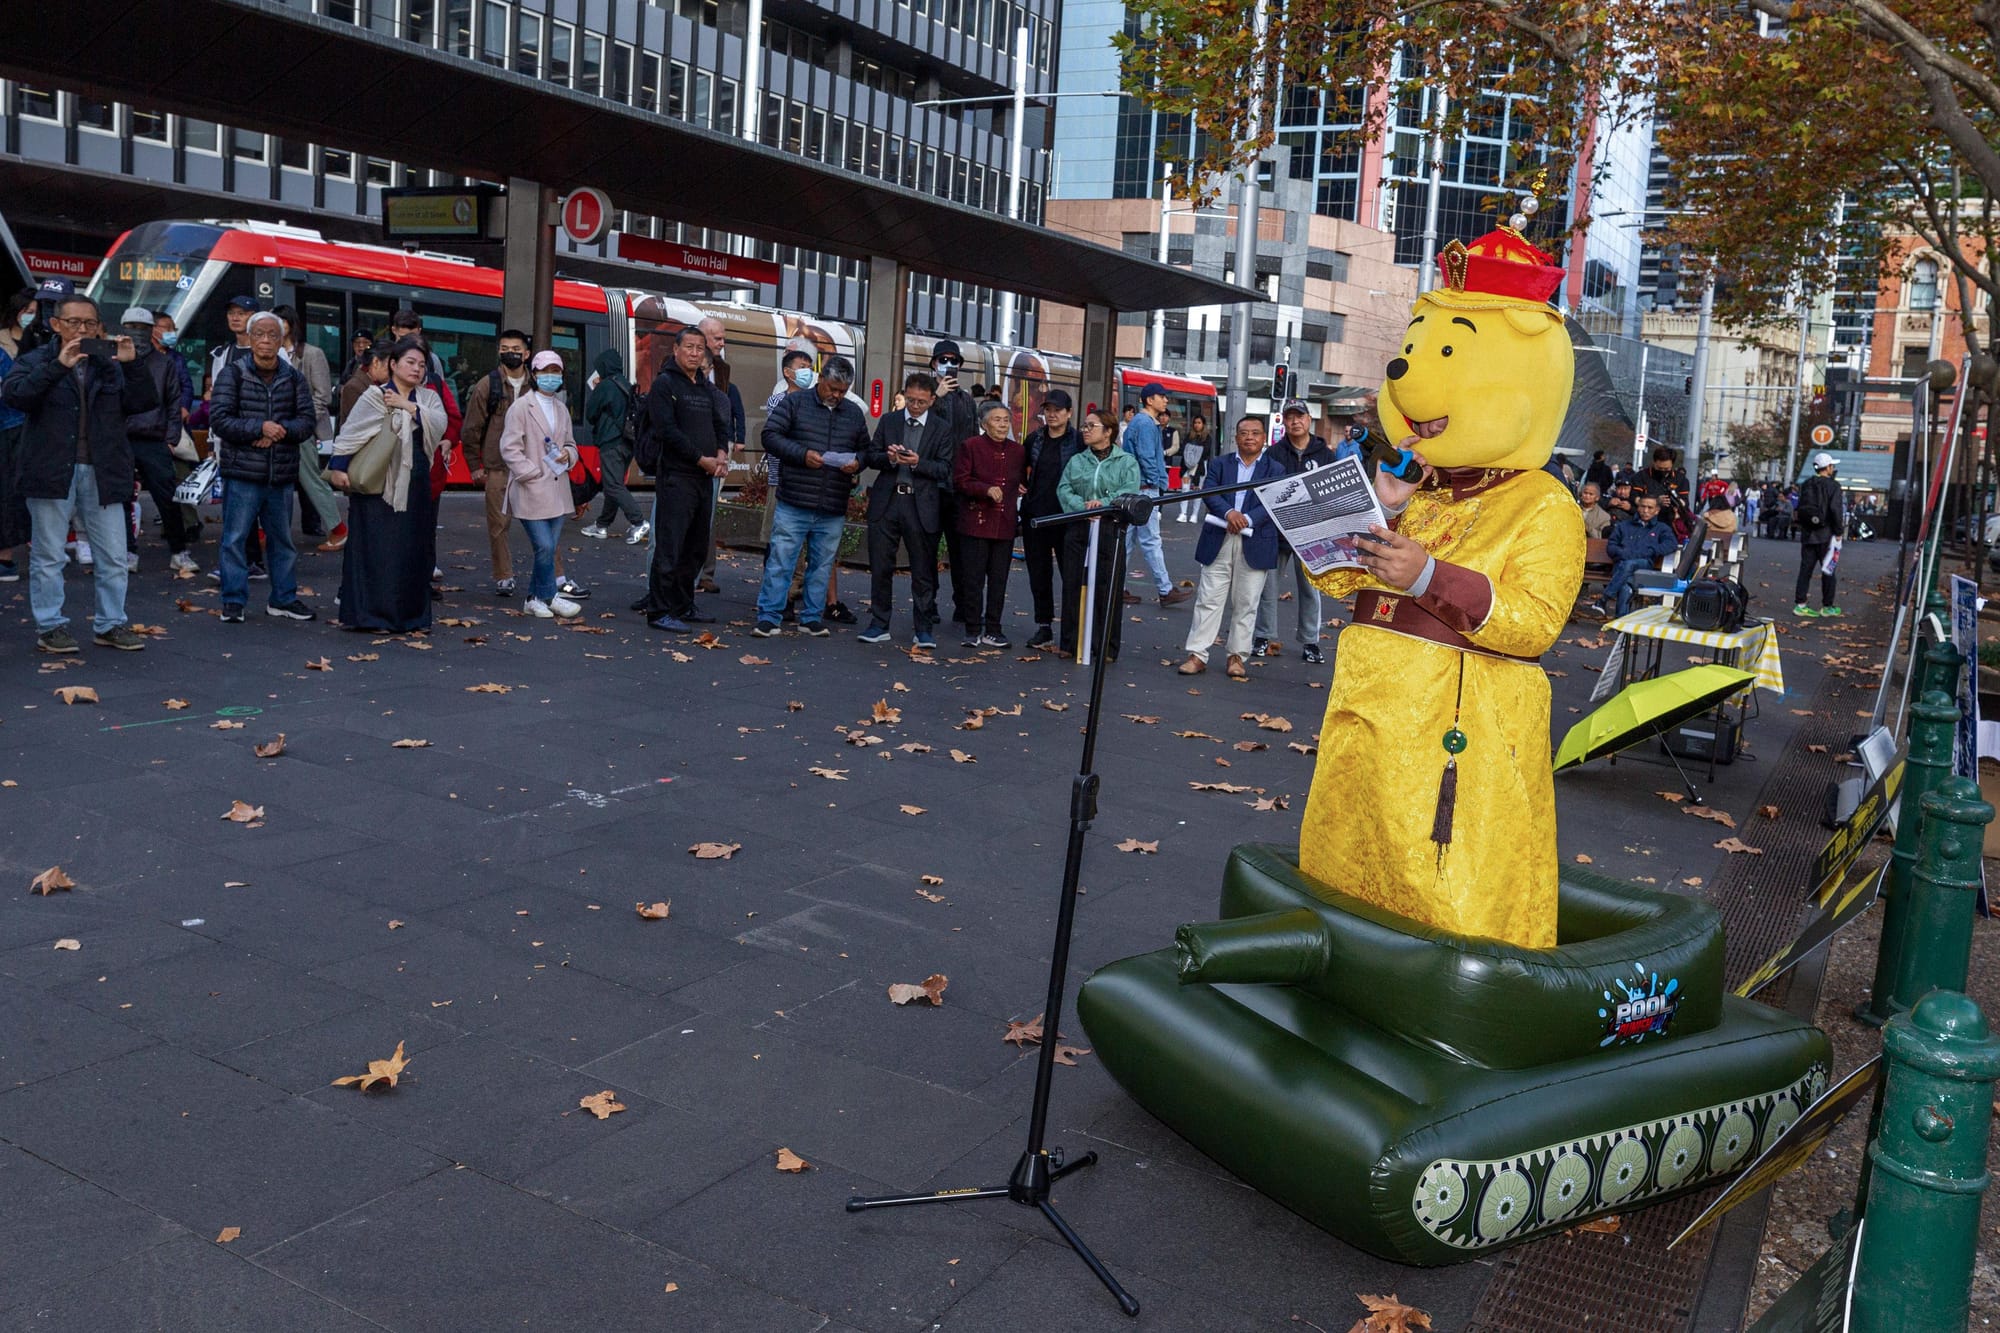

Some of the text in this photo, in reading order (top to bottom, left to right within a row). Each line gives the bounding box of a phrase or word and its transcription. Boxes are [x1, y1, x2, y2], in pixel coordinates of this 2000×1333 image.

[575, 199, 590, 230] L
[28, 255, 84, 273] Town Hall
[119, 261, 183, 282] L2 Randwick
[682, 250, 728, 272] Town Hall
[1818, 429, 1829, 442] T
[1311, 468, 1358, 490] TIANANMEN
[1318, 476, 1362, 497] MASSACRE
[1615, 993, 1674, 1026] POOL
